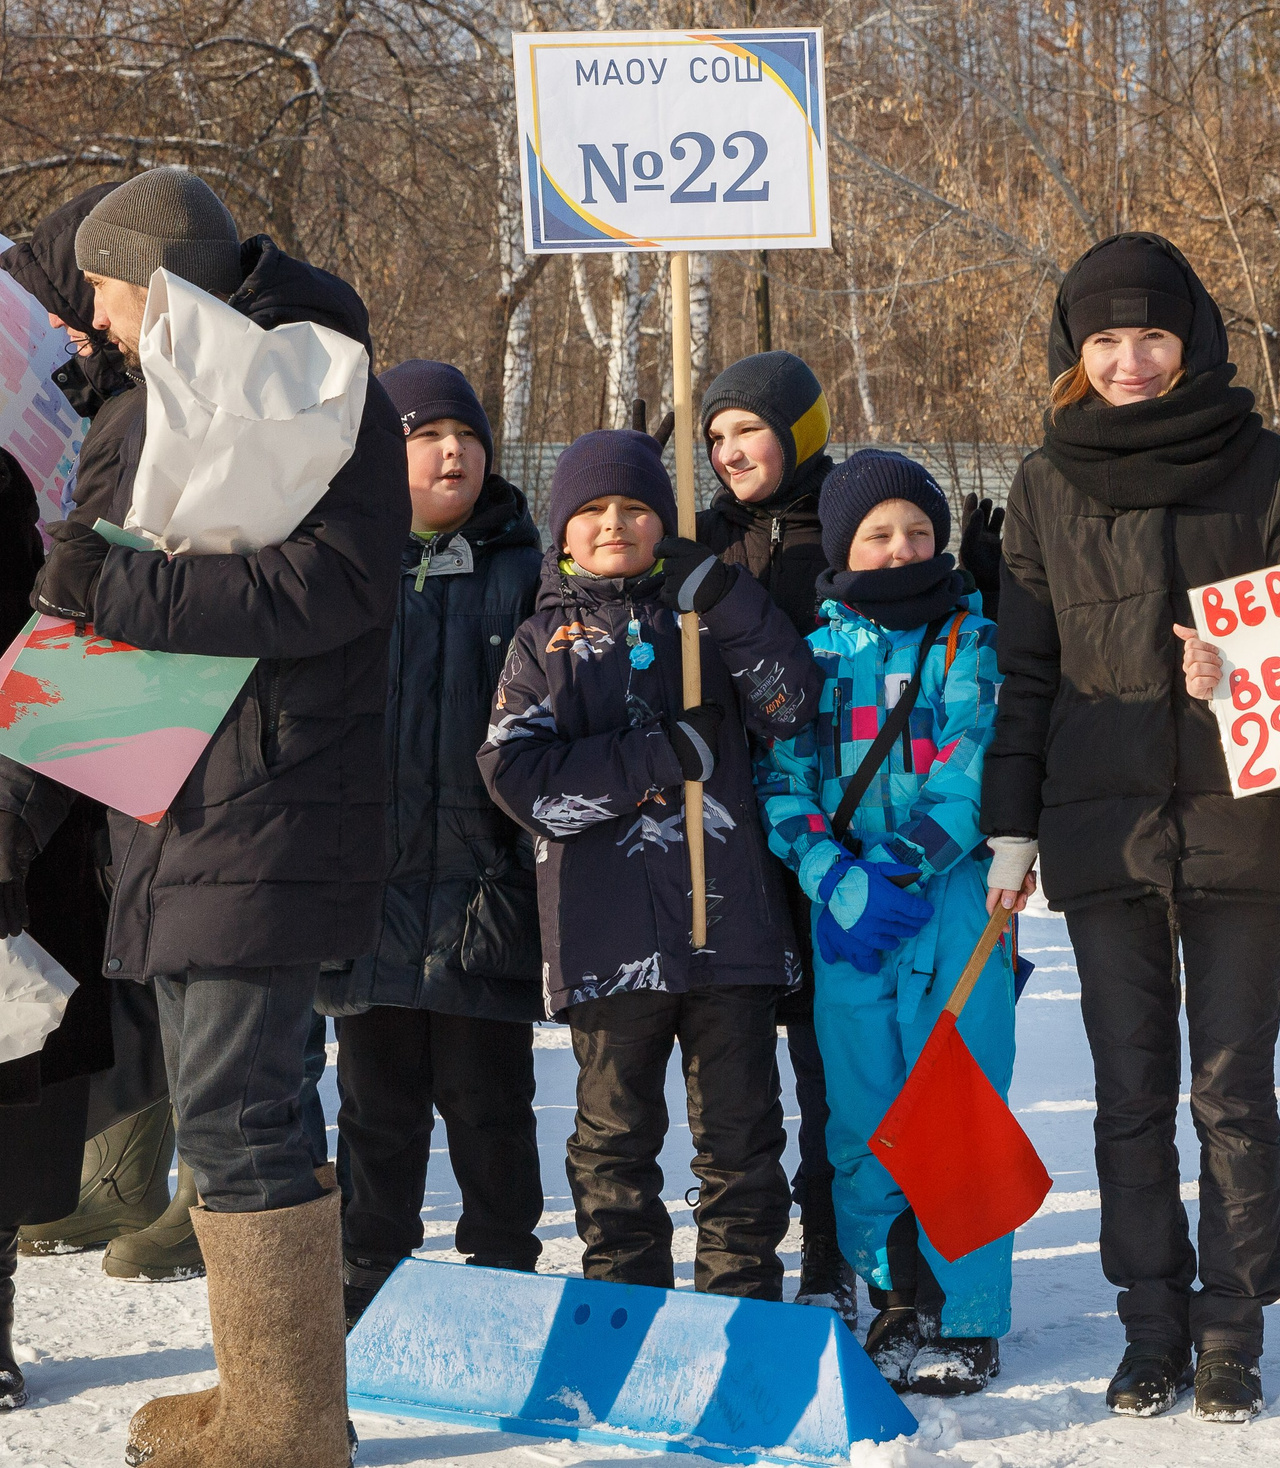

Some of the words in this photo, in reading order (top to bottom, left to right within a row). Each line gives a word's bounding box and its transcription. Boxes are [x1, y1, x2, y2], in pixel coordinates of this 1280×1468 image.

[575, 57, 667, 86] МАОУ
[689, 56, 763, 84] СОШ
[577, 130, 770, 204] №22
